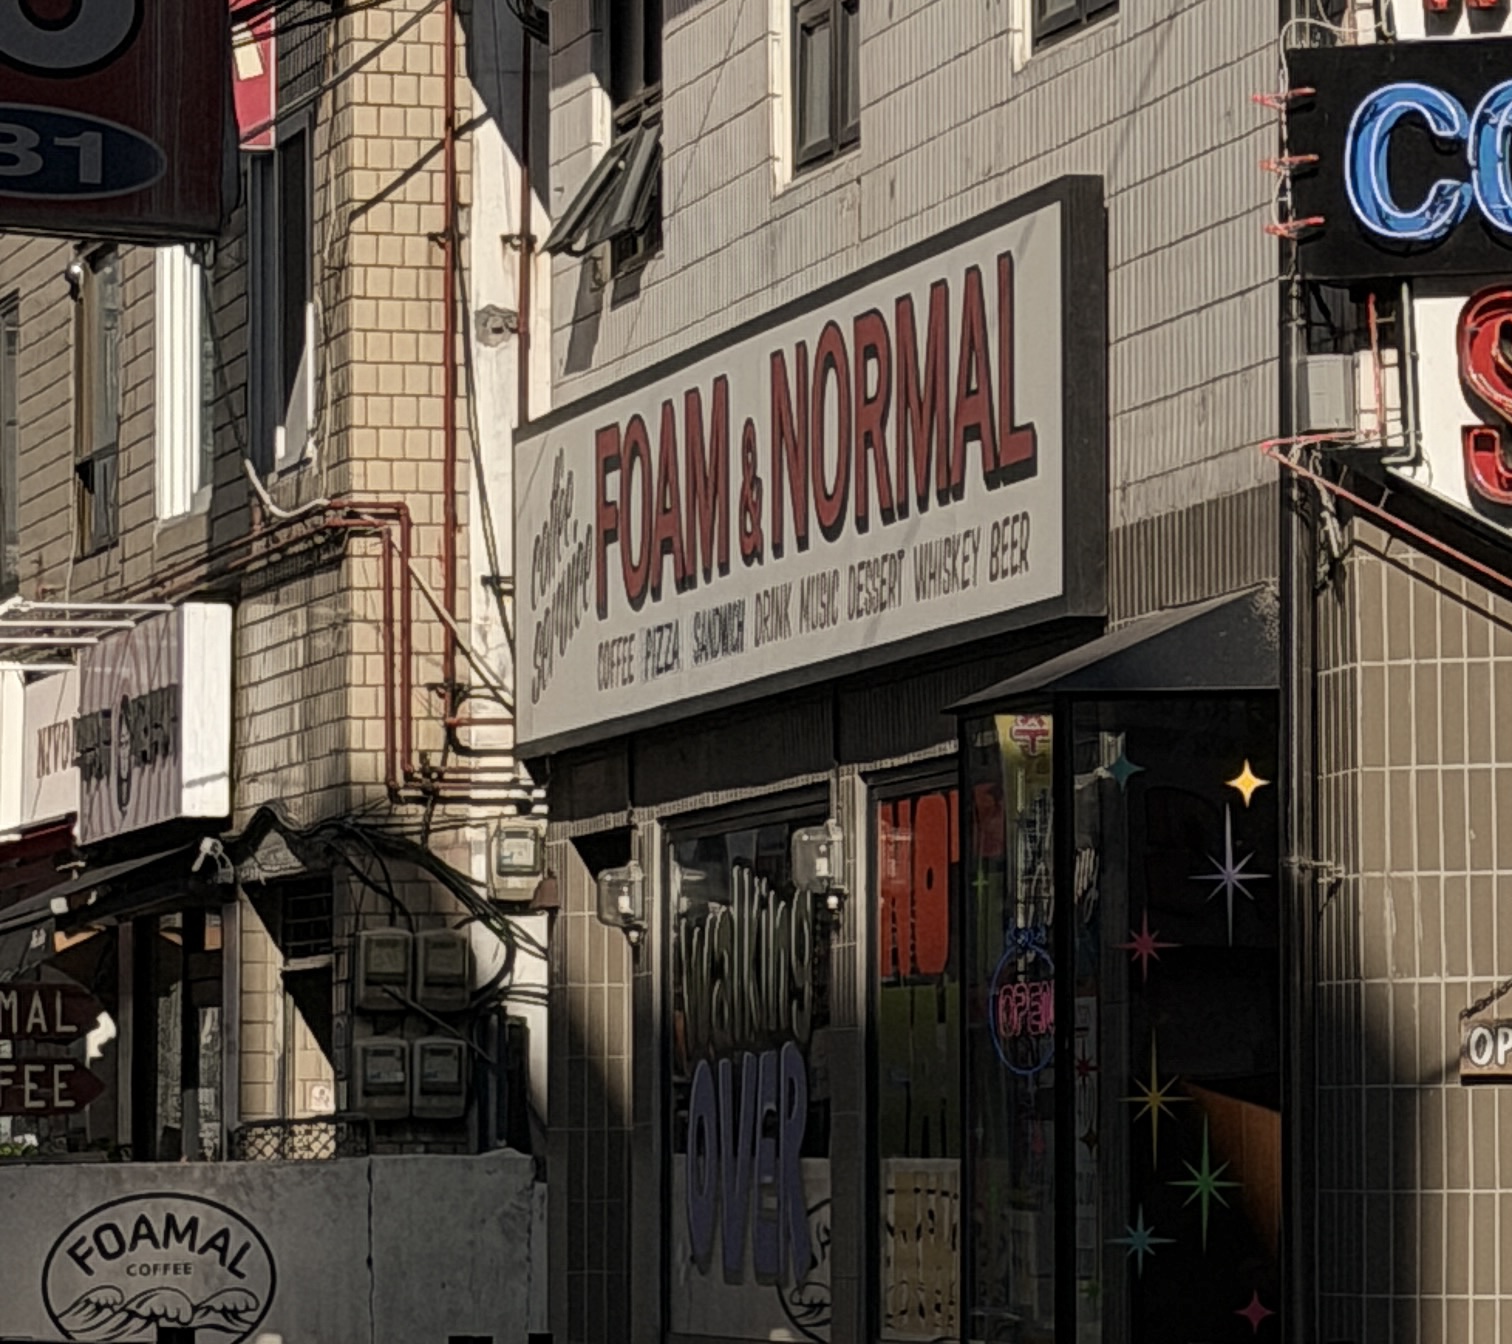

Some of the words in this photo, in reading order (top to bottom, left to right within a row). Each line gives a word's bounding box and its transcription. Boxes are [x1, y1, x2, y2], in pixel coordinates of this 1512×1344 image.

[595, 373, 730, 621] FOAM
[739, 417, 764, 567] &
[769, 250, 1038, 554] NORMAL
[597, 633, 636, 692] COFFEE
[644, 618, 680, 683] PIZZA
[754, 582, 793, 648] DRINK
[799, 568, 840, 635] MUSIC
[848, 549, 906, 622] DESSERT
[913, 526, 982, 603] WHISKEY
[989, 511, 1031, 583] BEER
[67, 1212, 251, 1280] FOAMAL
[687, 1040, 813, 1286] OVER
[126, 1262, 193, 1277] COFFEE
